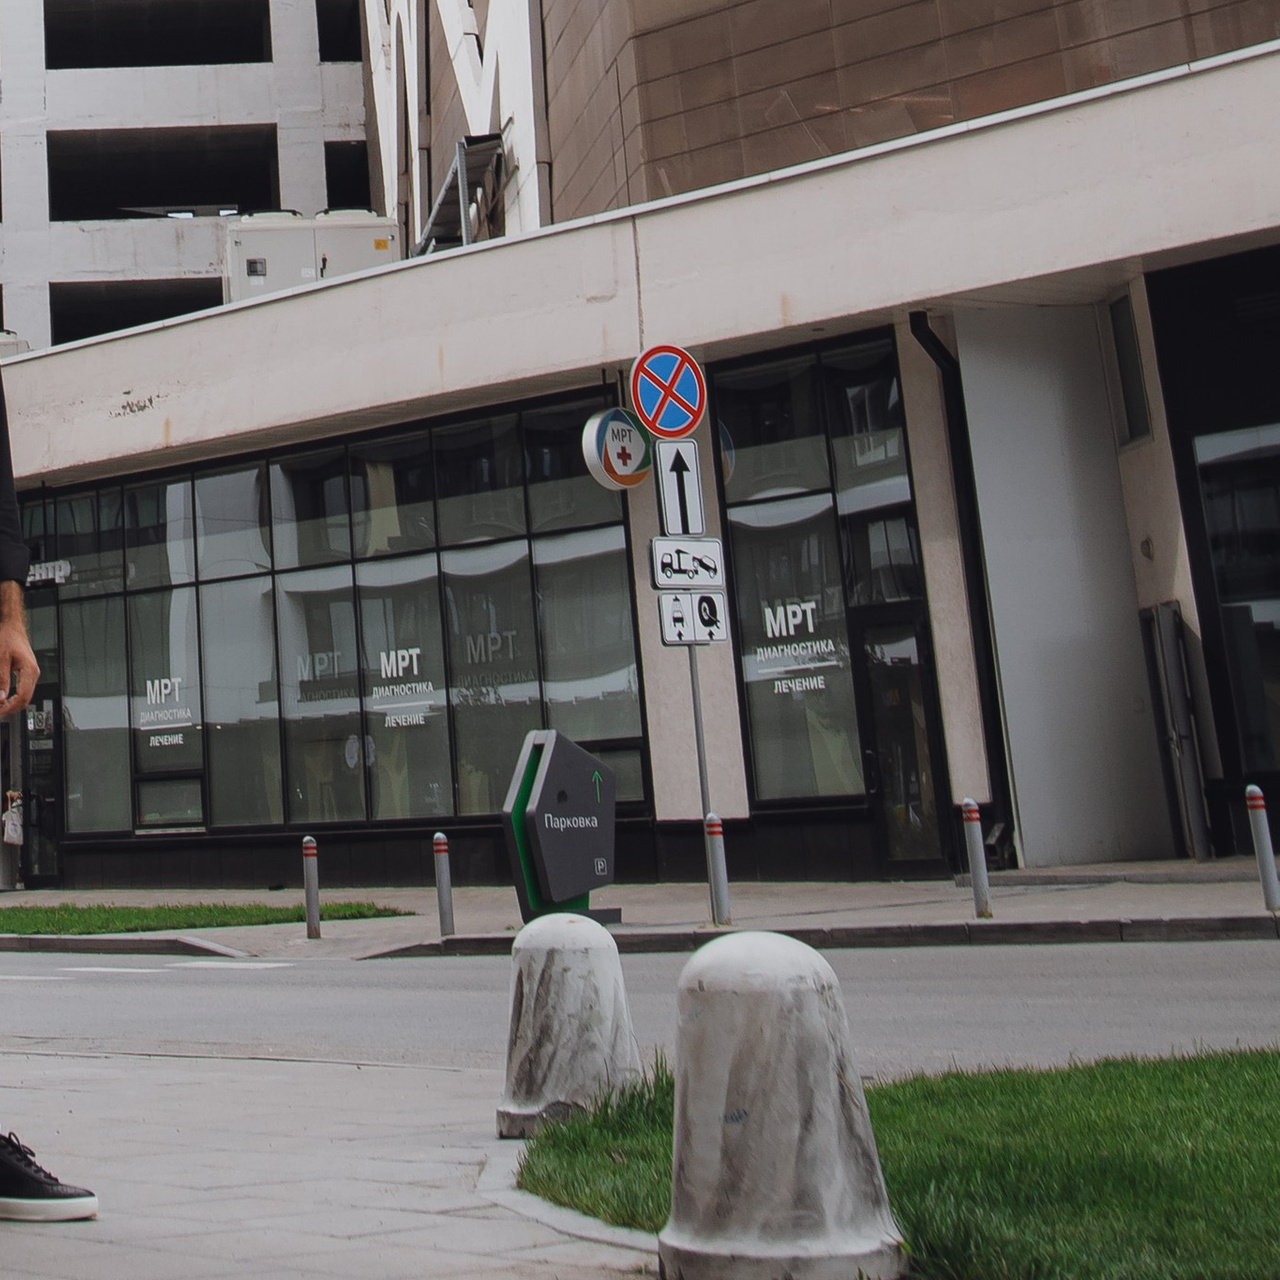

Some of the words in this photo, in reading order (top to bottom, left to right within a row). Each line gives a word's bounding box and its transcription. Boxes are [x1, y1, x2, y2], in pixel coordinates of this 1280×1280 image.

[611, 428, 633, 443] МРТ
[764, 601, 817, 638] МРТ
[466, 630, 518, 664] МРТ
[756, 639, 836, 662] ДИАГНОСТИКА
[296, 651, 342, 682] МРТ
[379, 648, 421, 679] МРТ
[146, 678, 182, 705] МРТ
[372, 681, 434, 700] ДИАГНОСТИКА
[774, 676, 826, 694] ЛЕЧЕНИЕ
[140, 707, 192, 724] ДИАГНОСТИКА
[385, 713, 426, 728] ЛЕЧЕНИЕ
[149, 733, 184, 747] ЛЕЧЕНИЕ
[544, 813, 598, 832] Парковка
